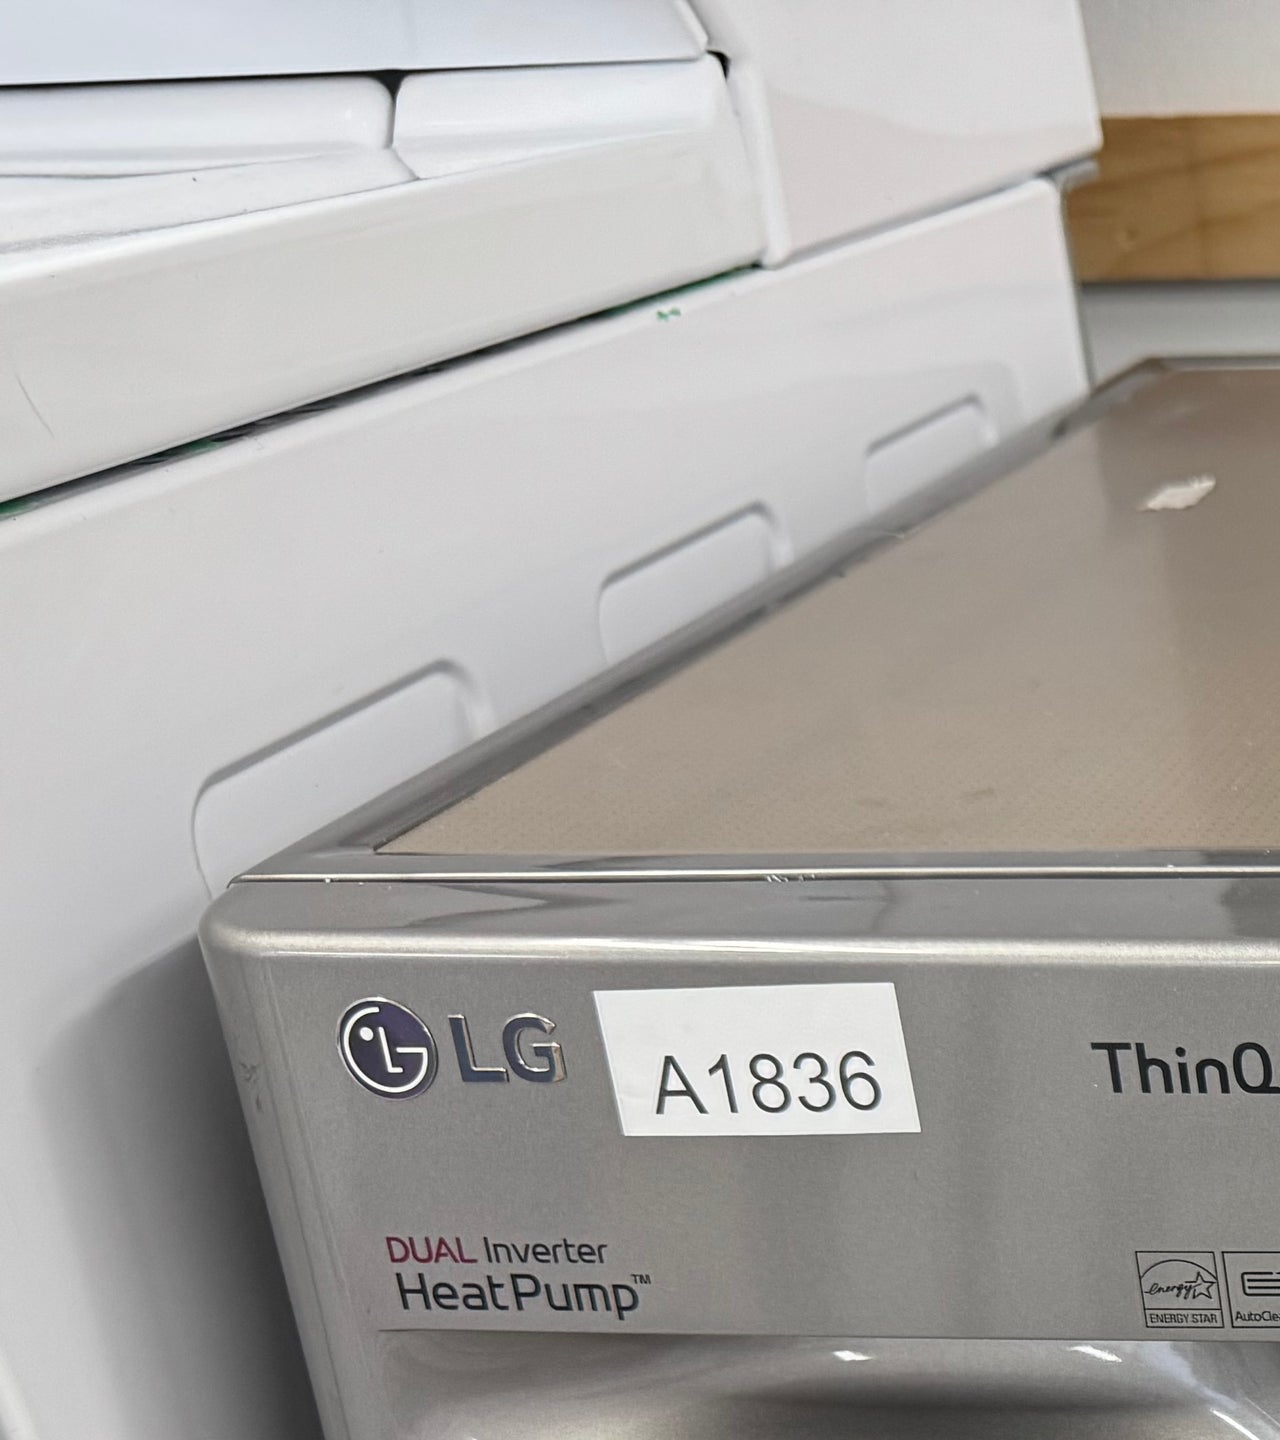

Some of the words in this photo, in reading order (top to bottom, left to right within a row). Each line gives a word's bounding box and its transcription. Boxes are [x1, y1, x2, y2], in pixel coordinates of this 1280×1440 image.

[449, 1013, 566, 1084] LG
[656, 1050, 883, 1115] A1836
[386, 1236, 477, 1265] DUAL
[482, 1236, 608, 1265] Inverter
[1150, 1312, 1189, 1324] ENERGY
[1192, 1313, 1218, 1324] STAR
